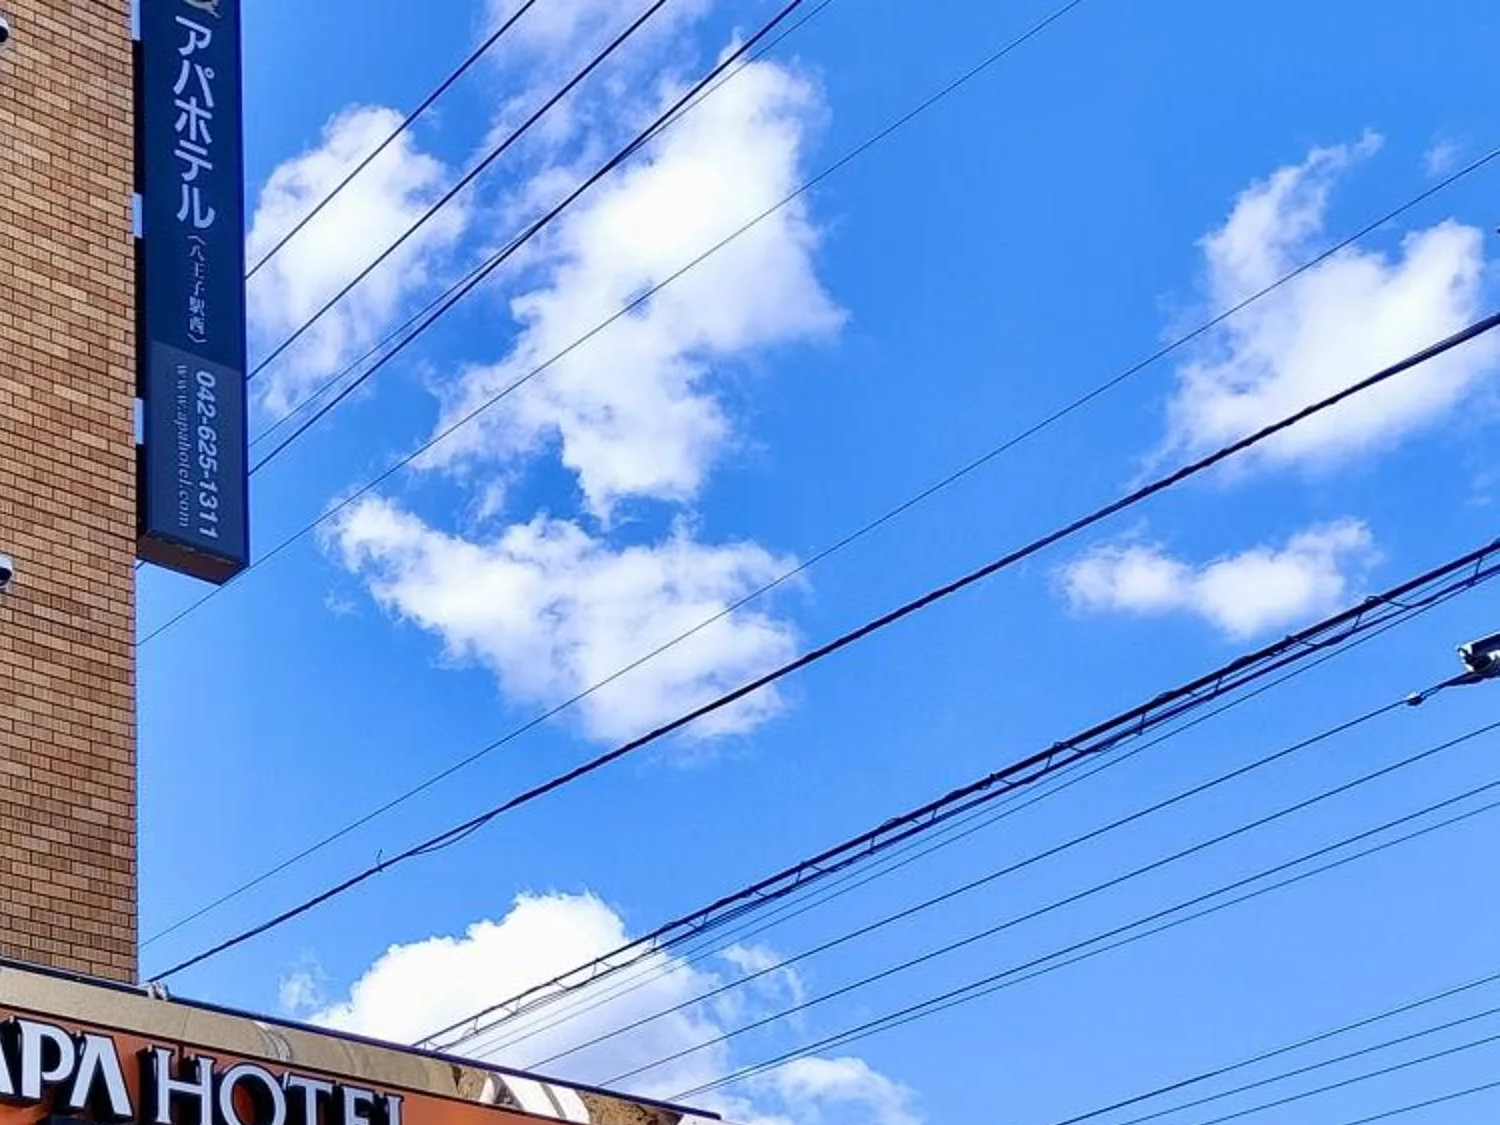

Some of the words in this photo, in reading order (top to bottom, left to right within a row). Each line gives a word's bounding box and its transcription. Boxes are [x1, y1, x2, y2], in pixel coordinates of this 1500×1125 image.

[172, 15, 217, 230] アパホテル
[173, 364, 194, 529] www.apahotel.com
[195, 370, 219, 540] 042-625-1311
